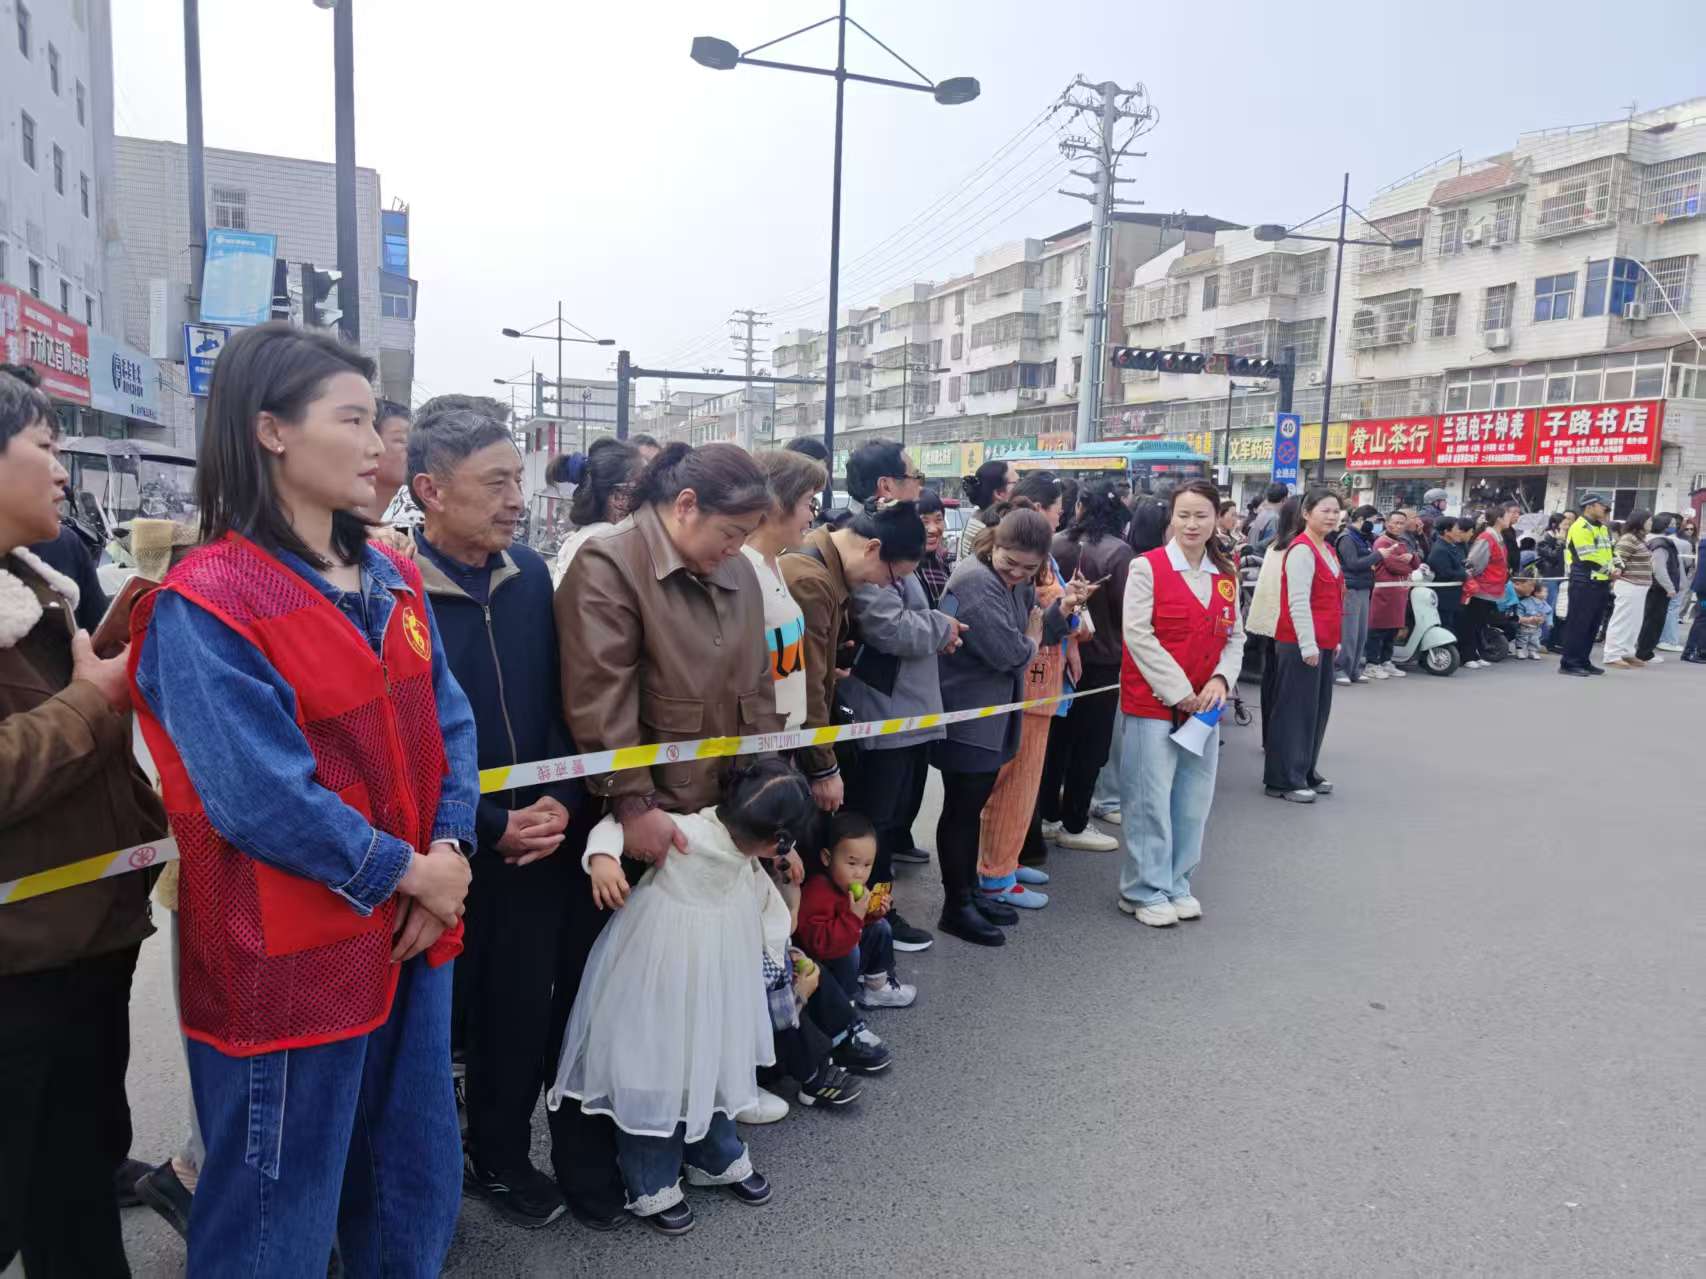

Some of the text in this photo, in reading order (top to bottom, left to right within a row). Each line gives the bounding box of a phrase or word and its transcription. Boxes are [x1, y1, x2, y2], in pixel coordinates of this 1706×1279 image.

[1283, 423, 1293, 433] 40
[1544, 406, 1648, 436] 子路书店
[1351, 424, 1430, 454] 黄山茶行
